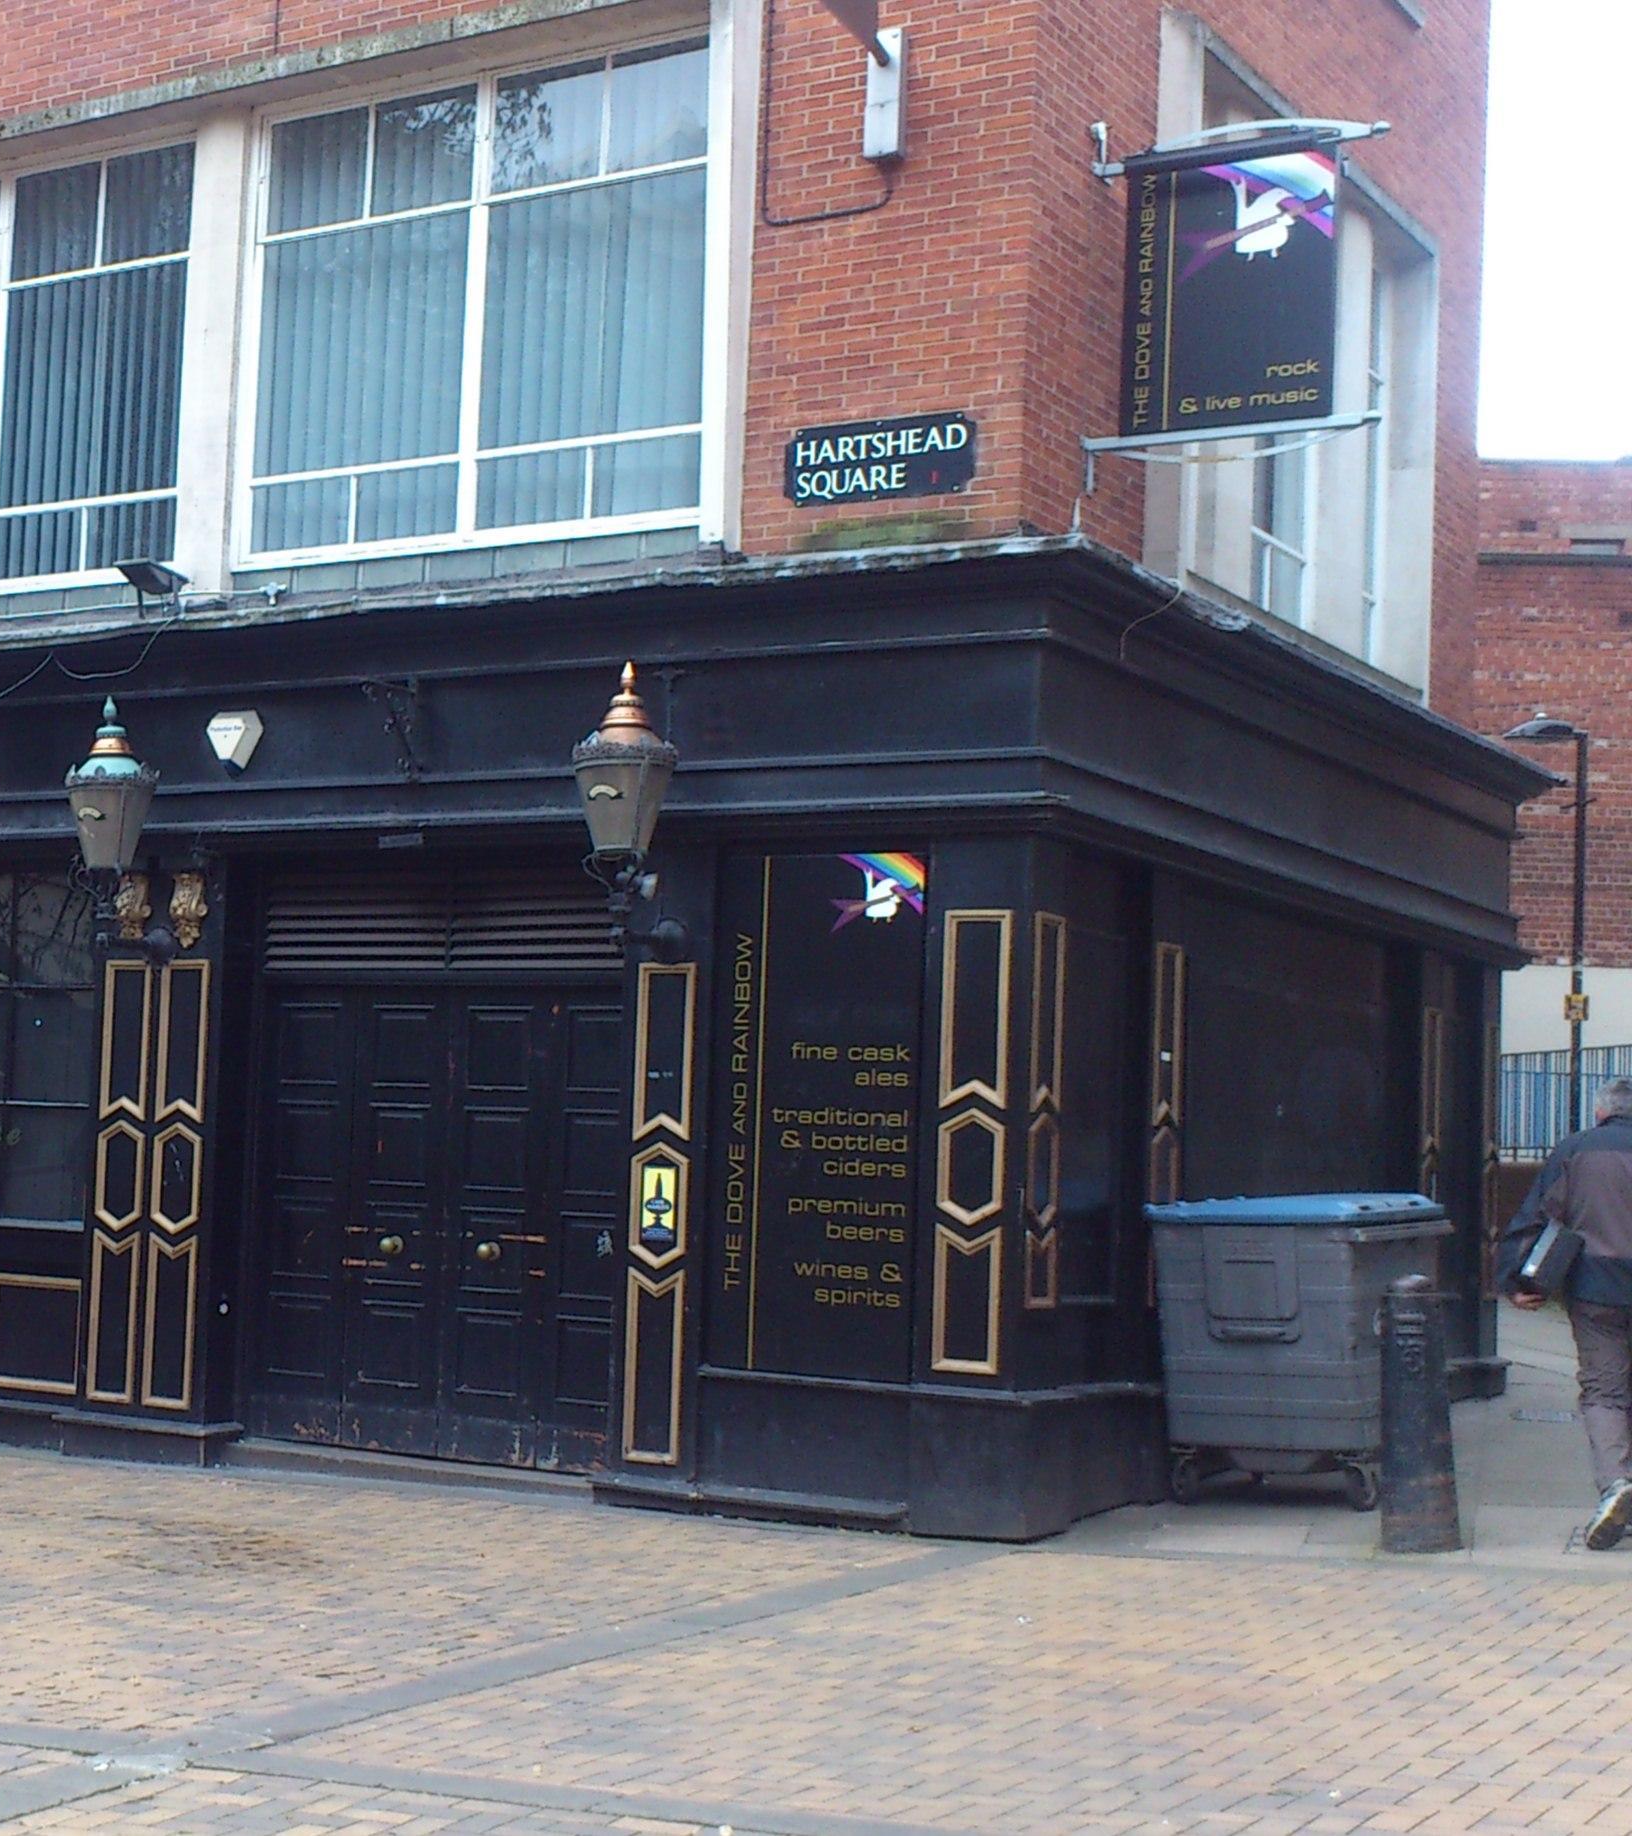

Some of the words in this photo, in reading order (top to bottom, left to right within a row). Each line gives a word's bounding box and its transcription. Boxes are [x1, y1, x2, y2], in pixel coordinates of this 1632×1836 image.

[1139, 174, 1158, 274] RAINBOW
[1139, 278, 1155, 317] AND
[1134, 322, 1151, 380] DOVE
[1266, 358, 1320, 379] rock
[1132, 386, 1149, 428] THE
[1178, 396, 1199, 413] &
[1205, 395, 1242, 412] live
[1248, 387, 1319, 407] music
[795, 423, 968, 467] HARTSHEAD
[796, 463, 907, 500] SQUARE
[730, 933, 754, 1074] RAINBOW
[791, 1042, 838, 1061] fine
[847, 1043, 911, 1063] cask
[854, 1068, 909, 1087] ales
[734, 1082, 748, 1135] AND
[771, 1106, 908, 1128] traditional
[780, 1130, 801, 1149] &
[811, 1130, 908, 1153] bottled
[822, 1157, 906, 1178] ciders
[725, 1143, 746, 1223] DOVE
[787, 1197, 906, 1217] premium
[826, 1220, 904, 1243] beers
[724, 1227, 742, 1290] THE
[793, 1262, 868, 1281] wines
[879, 1263, 902, 1283] &
[814, 1287, 901, 1309] spirits
